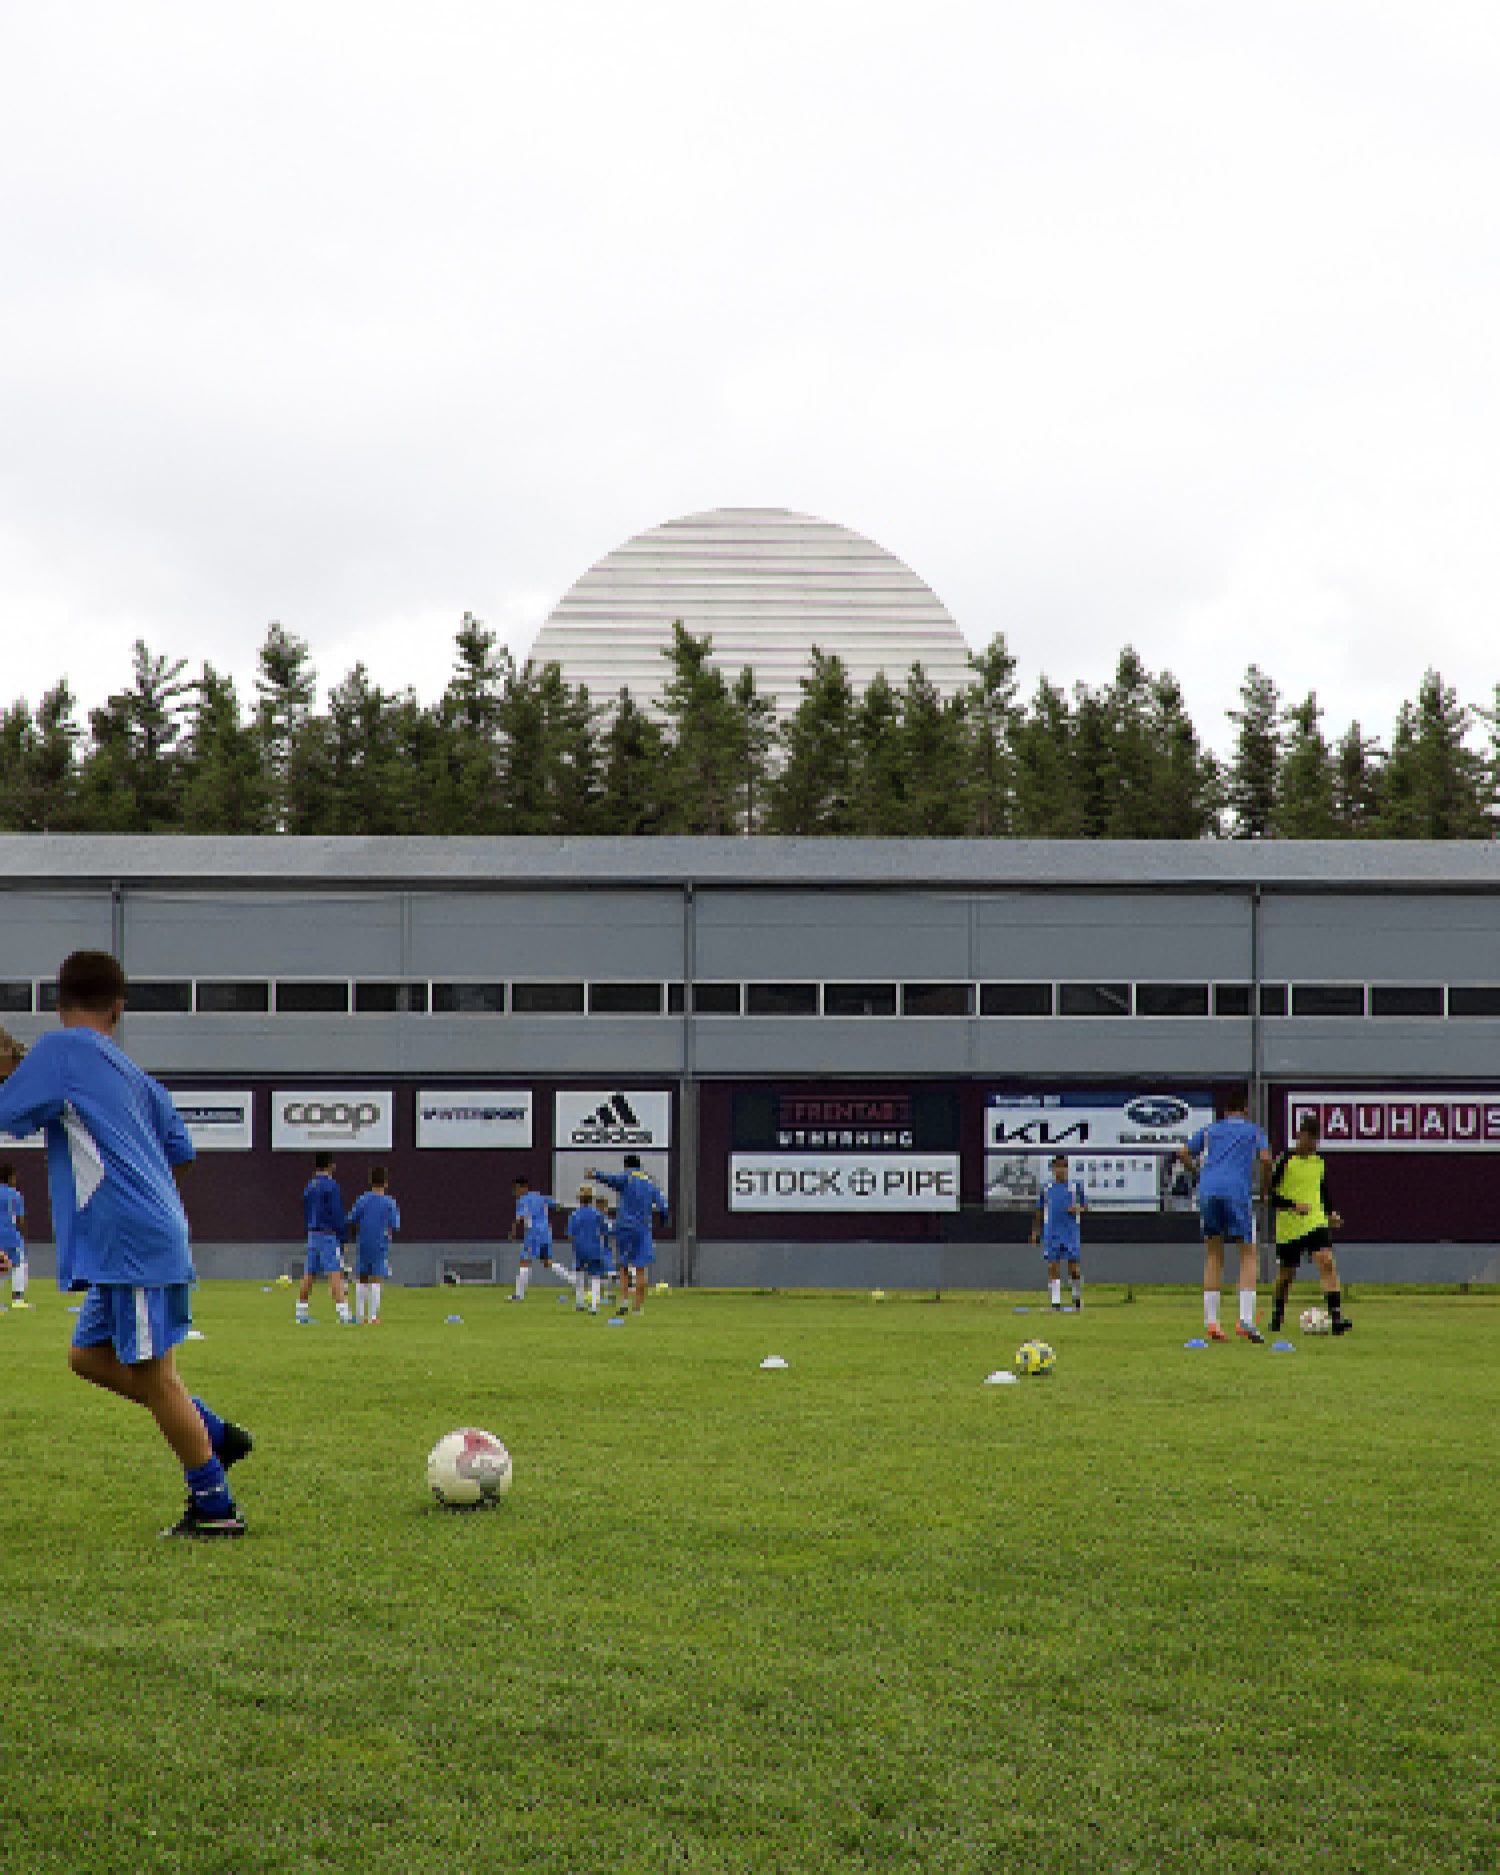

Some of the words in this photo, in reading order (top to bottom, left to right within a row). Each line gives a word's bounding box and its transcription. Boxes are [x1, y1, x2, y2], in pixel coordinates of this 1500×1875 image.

[282, 1102, 381, 1132] coop
[994, 1118, 1089, 1144] KIA
[735, 1166, 844, 1197] STOCK
[883, 1166, 953, 1197] PIPE
